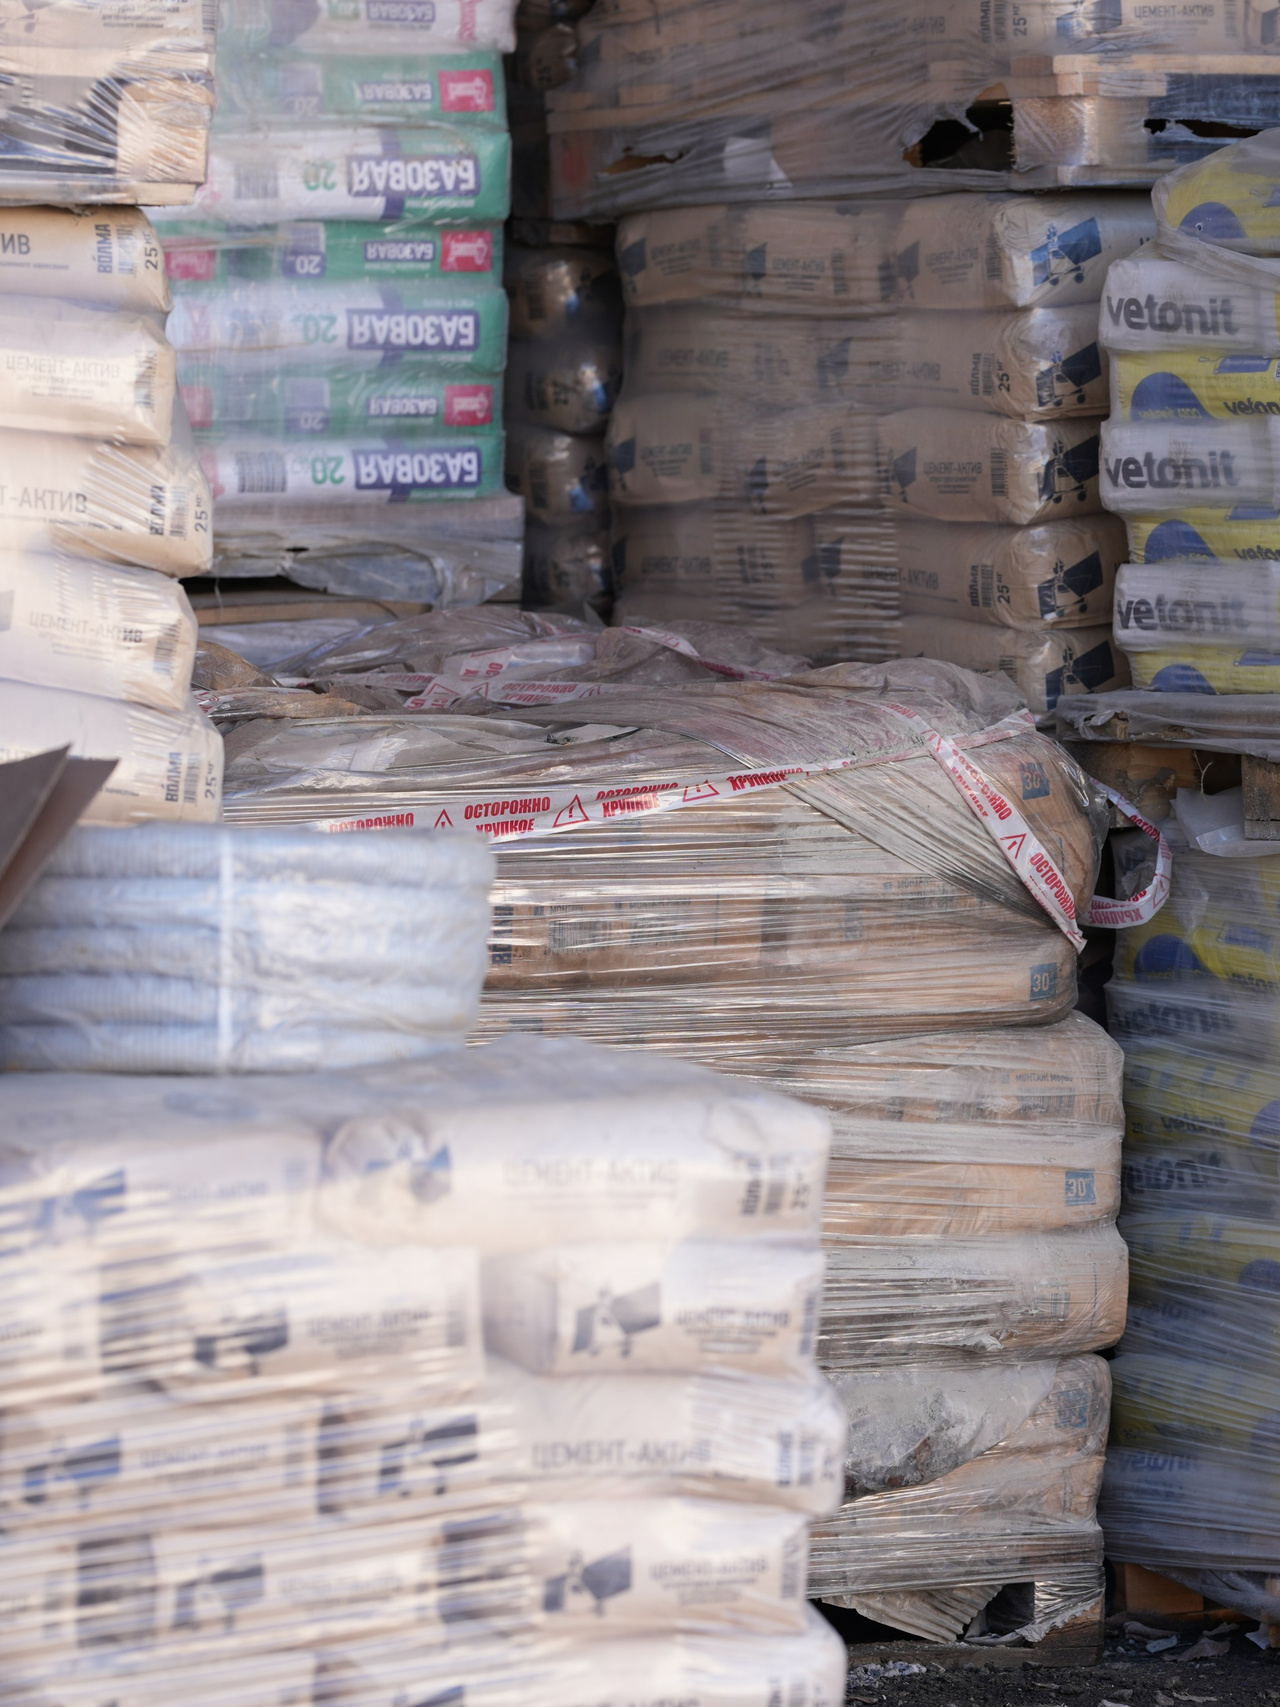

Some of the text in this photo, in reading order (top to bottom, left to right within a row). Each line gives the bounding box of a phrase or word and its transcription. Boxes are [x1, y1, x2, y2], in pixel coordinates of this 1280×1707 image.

[1133, 5, 1215, 19] ЦЕМЕНТ-АКТИВ
[1013, 16, 1027, 37] 25
[361, 82, 433, 101] БАЗОВАЯ
[303, 161, 337, 191] 20
[350, 158, 476, 192] БАЗОВАЯ
[144, 247, 158, 271] 25
[366, 241, 434, 260] БАЗОВАЯ
[295, 255, 321, 275] 20
[1105, 293, 1241, 336] vetonit
[301, 315, 339, 343] 20
[350, 314, 475, 347] БАЗОВАЯ
[6, 354, 121, 379] ЦЕМЕНТ-АКТИВ
[997, 372, 1011, 393] 25
[369, 397, 438, 416] БАЗОВАЯ
[310, 455, 345, 485] 20
[358, 451, 478, 485] БАЗОВАЯ
[922, 461, 983, 476] ЦЕМЕНТ-АКТИВ
[1105, 450, 1242, 490] vetonit
[194, 509, 209, 533] 25
[997, 584, 1011, 605] 25
[1116, 592, 1251, 632] vetonit
[29, 610, 143, 644] ЦЕМЕНТ-АКТИВ
[501, 682, 578, 695] ОСТОРОЖНО
[204, 775, 217, 800] 25
[951, 748, 1014, 822] ОСТОРОЖНО
[1024, 772, 1042, 791] 30
[463, 796, 551, 820] ОСТОРОЖНО
[602, 791, 661, 818] ХРУПКОЕ
[475, 817, 535, 835] ХРУПКОЕ
[1029, 851, 1076, 921] ОСТОРОЖНО
[1032, 973, 1050, 993] 30
[1068, 1177, 1088, 1197] 30
